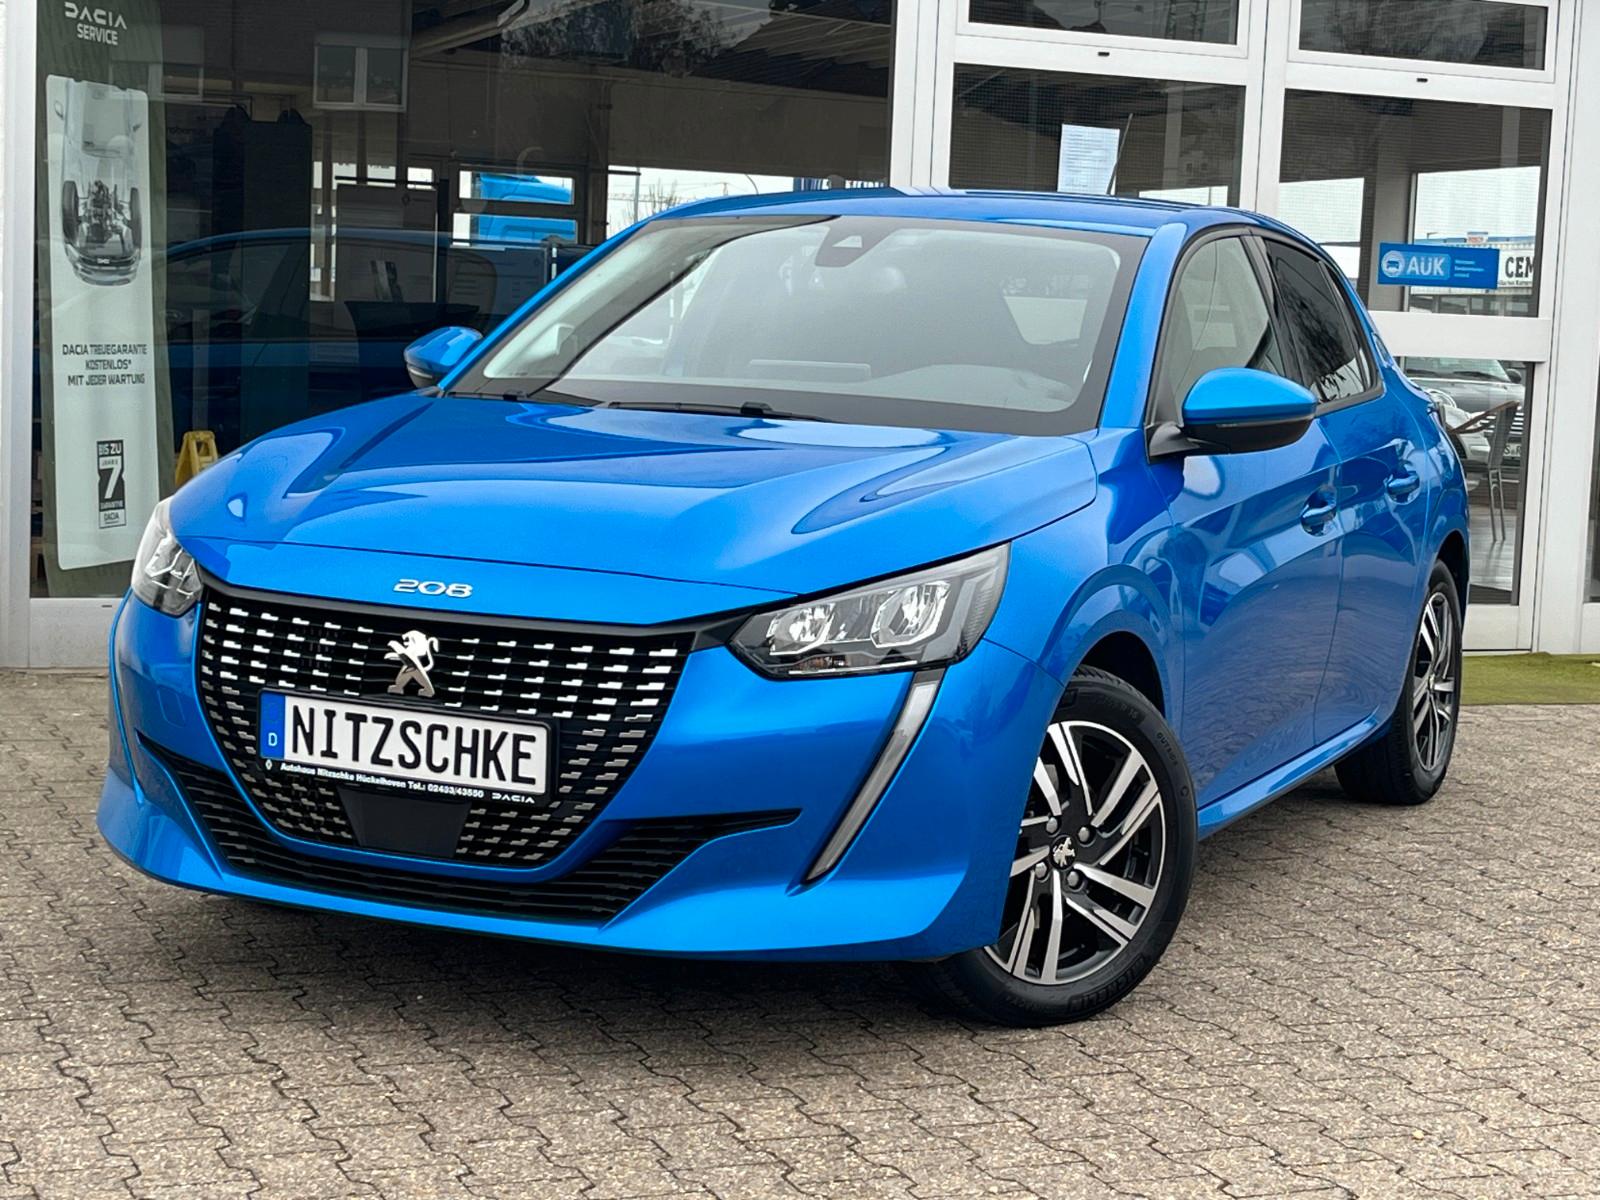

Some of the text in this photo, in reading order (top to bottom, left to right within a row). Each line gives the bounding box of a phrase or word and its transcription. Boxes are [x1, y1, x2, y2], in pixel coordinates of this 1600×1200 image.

[64, 1, 127, 30] DACIA
[77, 23, 118, 45] SERVICE
[62, 344, 88, 355] DACIA
[68, 373, 145, 386] MIT JEDER WARTUNG
[110, 442, 122, 454] ZU
[100, 456, 122, 500] 7
[393, 578, 473, 598] 208
[268, 732, 278, 747] D
[292, 704, 537, 786] NITZSCHKE
[281, 763, 316, 775] Autohaus
[317, 768, 355, 781] Nitzschke
[356, 773, 406, 789] Hückelhoven
[428, 783, 485, 799] 02433/43550
[492, 792, 536, 804] DACIA
